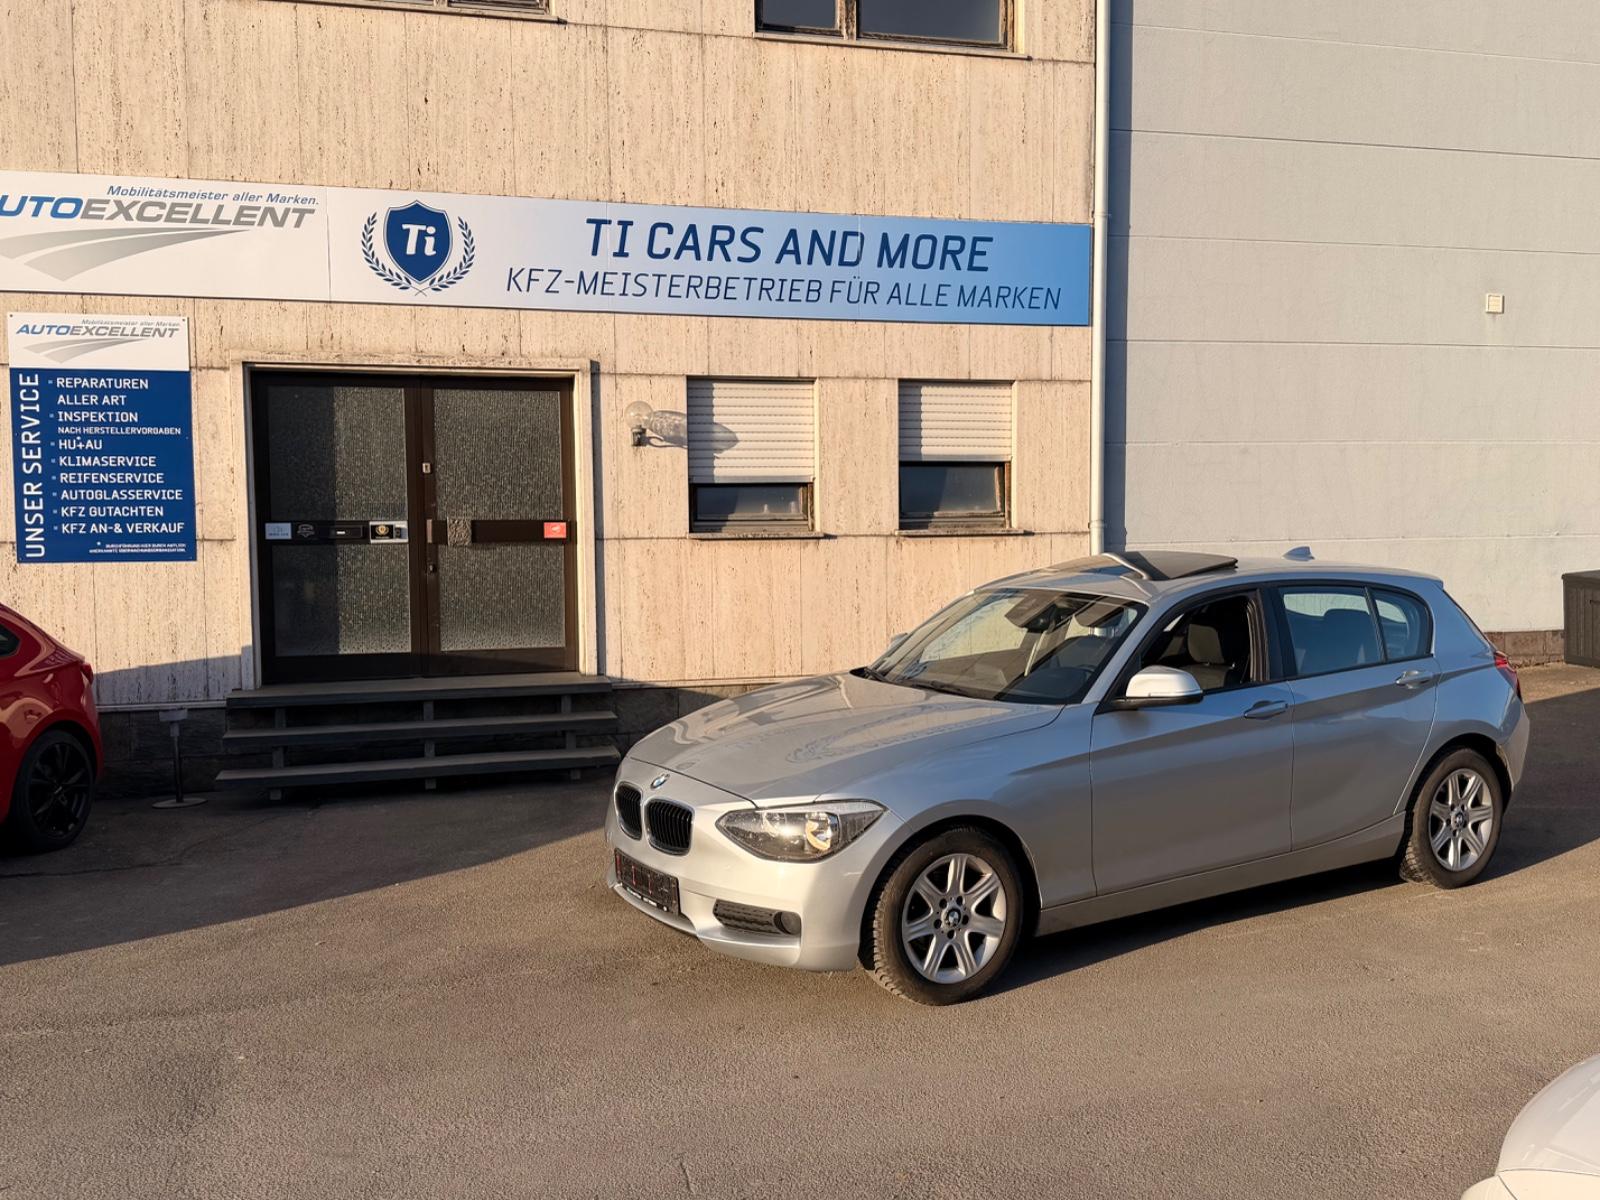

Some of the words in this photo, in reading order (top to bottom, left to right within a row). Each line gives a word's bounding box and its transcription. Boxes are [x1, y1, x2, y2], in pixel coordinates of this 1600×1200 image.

[106, 185, 229, 200] Mobilitätsmeister
[232, 191, 261, 202] aller
[266, 193, 319, 205] Marken.
[402, 223, 437, 256] Ti
[586, 218, 635, 258] TI
[646, 221, 764, 263] CARS
[775, 228, 865, 267] AND
[877, 232, 994, 272] MORE
[506, 267, 823, 303] KFZ-MEISTERBETRIEB
[829, 275, 881, 305] FÜR
[886, 283, 951, 307] ALLE
[956, 284, 1062, 310] MARKEN
[16, 324, 179, 338] AUTOEXCELLENT
[56, 377, 149, 390] REPARATUREN
[57, 394, 99, 405] ALLER
[101, 395, 127, 406] ART
[57, 411, 138, 423] INSPEKTION
[19, 374, 42, 474] SERVICE
[58, 426, 82, 434] NACH
[83, 426, 181, 435] HERSTELLERVORGABEN
[59, 456, 157, 467] KLIMASERVICE
[60, 473, 164, 484] REIFENSERVICE
[60, 489, 183, 500] AUTOGLASSERVICE
[61, 506, 86, 517] KFZ
[89, 506, 164, 517] GUTACHTEN
[23, 482, 45, 558] UNSER
[62, 523, 87, 534] KFZ
[126, 523, 185, 534] VERKAUF
